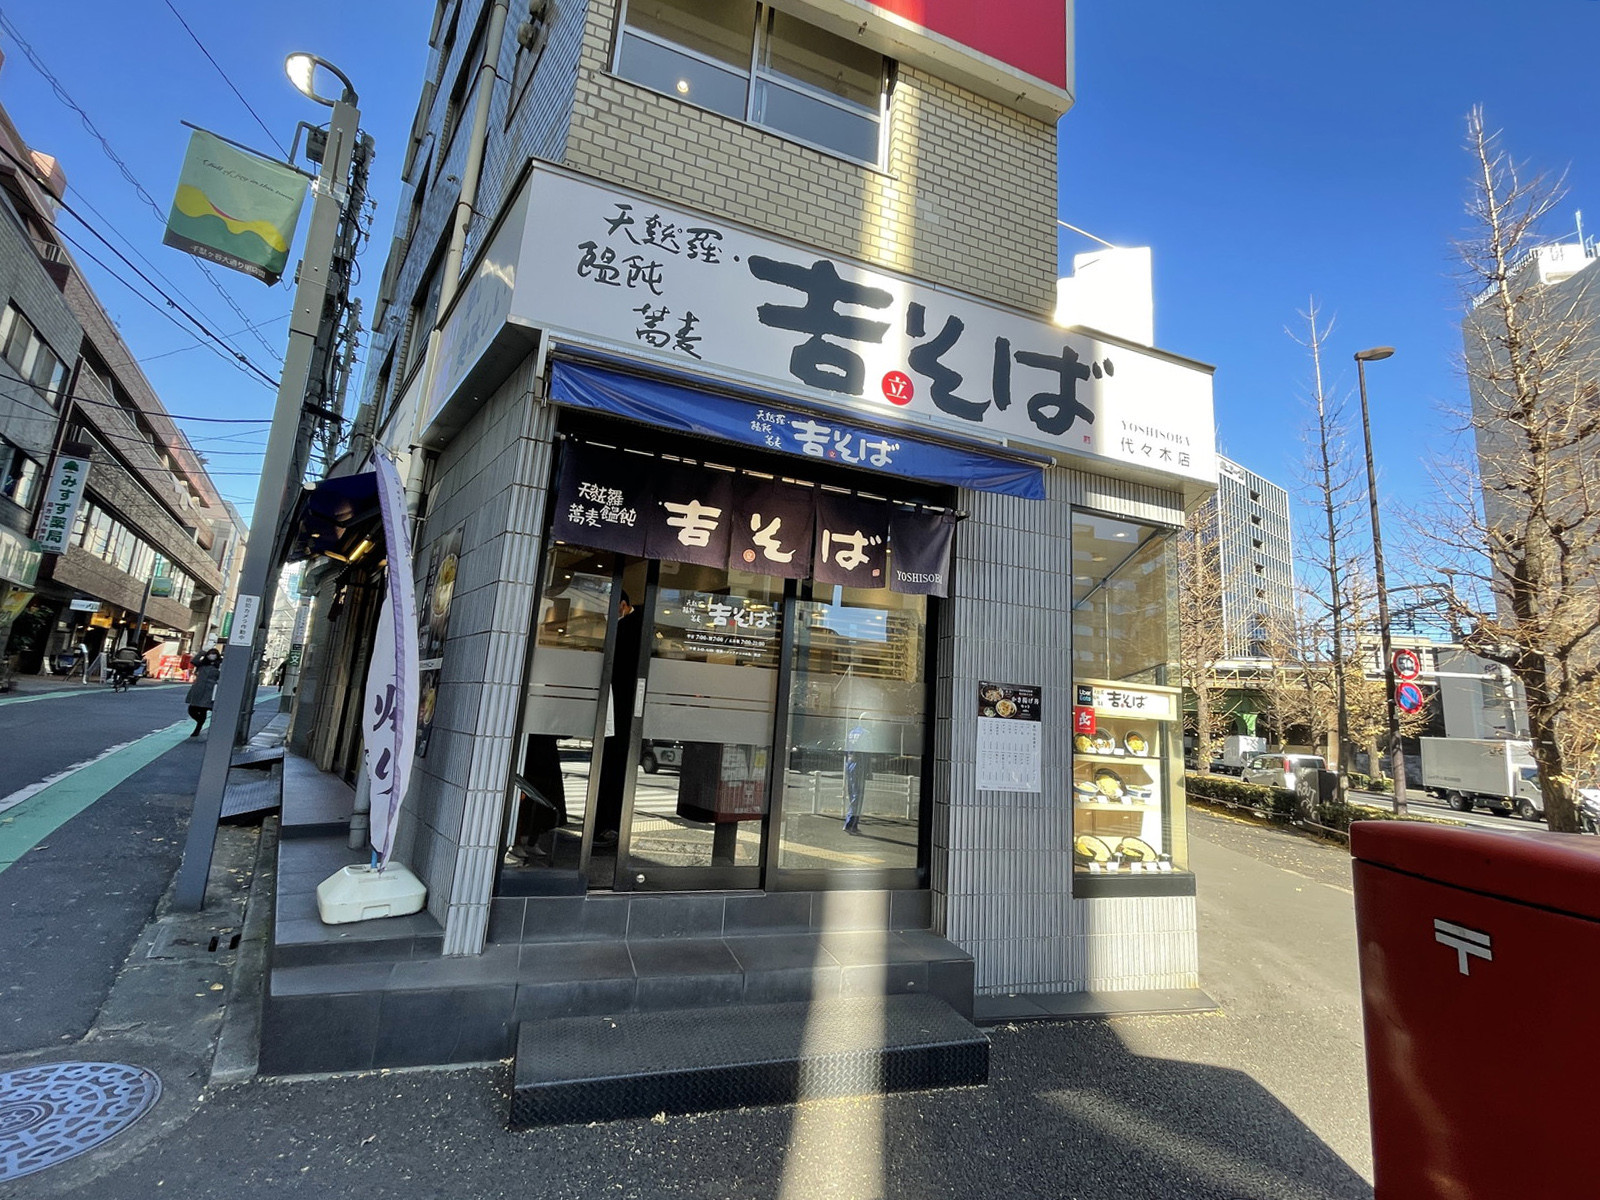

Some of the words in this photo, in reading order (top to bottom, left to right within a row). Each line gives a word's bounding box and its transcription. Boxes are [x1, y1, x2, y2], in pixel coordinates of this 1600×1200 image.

[576, 240, 664, 296] 饂飩
[632, 303, 703, 361] 蕎麦
[748, 257, 1115, 436] 吉そば
[884, 373, 911, 403] 立
[791, 419, 900, 468] 吉そば
[1121, 420, 1191, 447] YOSHISOBA
[1121, 436, 1191, 467] 代々木店
[46, 475, 77, 544] みすず薬局
[664, 499, 883, 571] 吉そば
[708, 602, 776, 629] 吉そば
[1106, 690, 1148, 709] 吉そば
